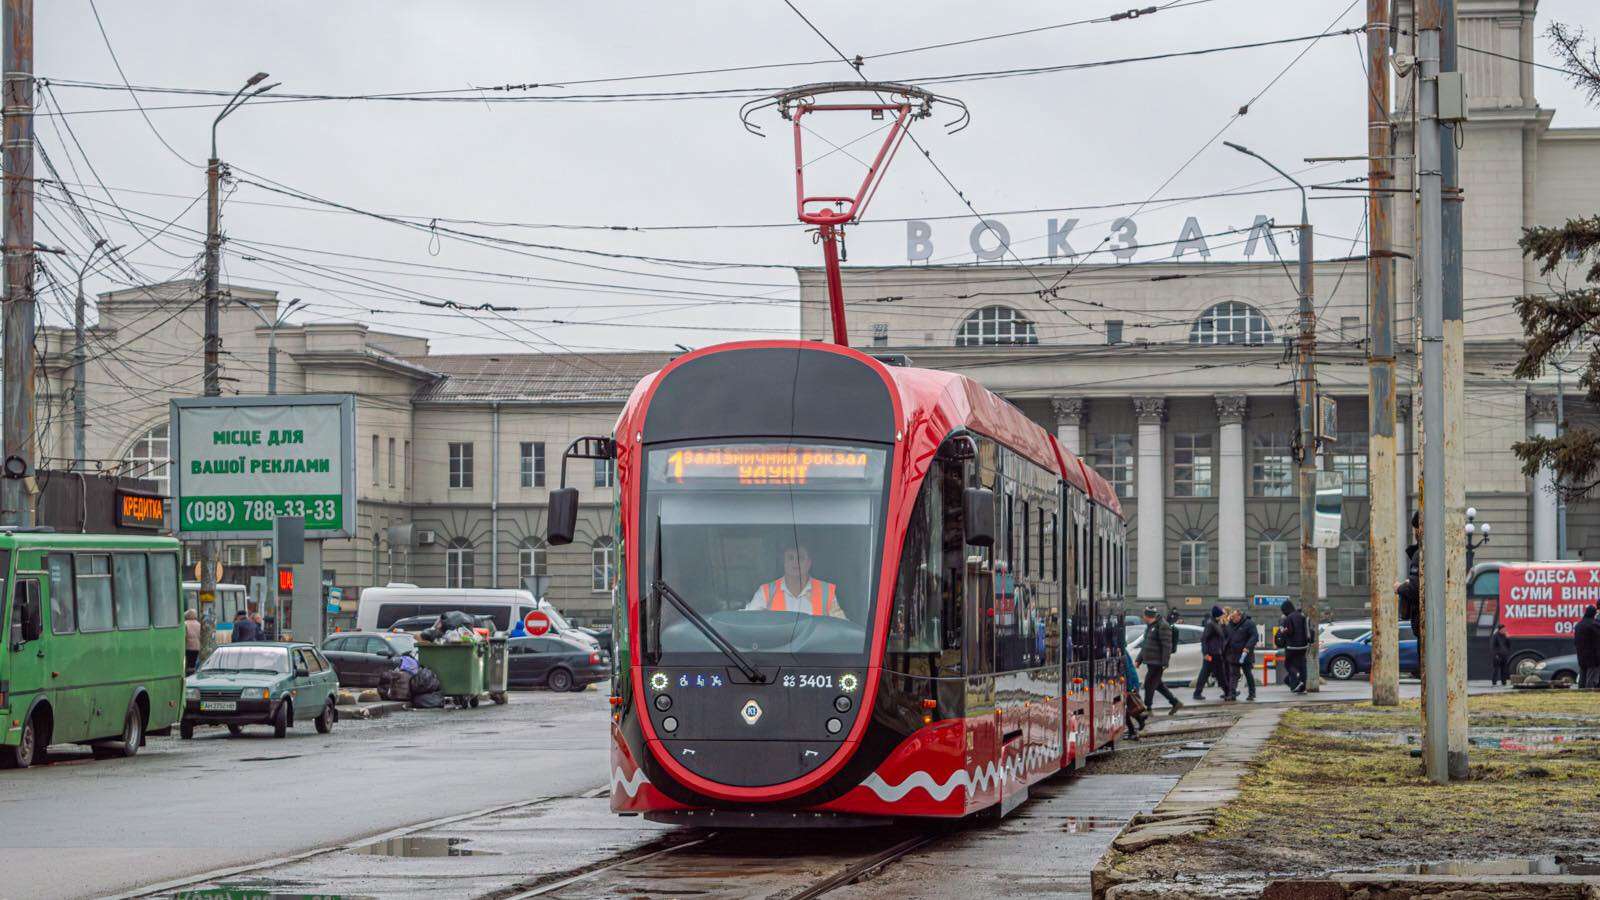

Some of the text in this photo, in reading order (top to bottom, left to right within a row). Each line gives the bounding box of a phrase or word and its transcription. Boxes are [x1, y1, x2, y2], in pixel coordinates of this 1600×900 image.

[906, 215, 1278, 260] ВОКЗАЛ
[213, 430, 304, 446] МІСЦЕ ДЛЯ
[191, 456, 330, 474] ВАШОЇ РЕКЛАМИ
[123, 495, 163, 520] КРЕДИТКА
[186, 500, 335, 524] (098) 788-33-33
[1524, 570, 1577, 585] ОДЕСА
[1510, 586, 1600, 600] СУМИ ВІНН
[799, 674, 833, 688] 3401
